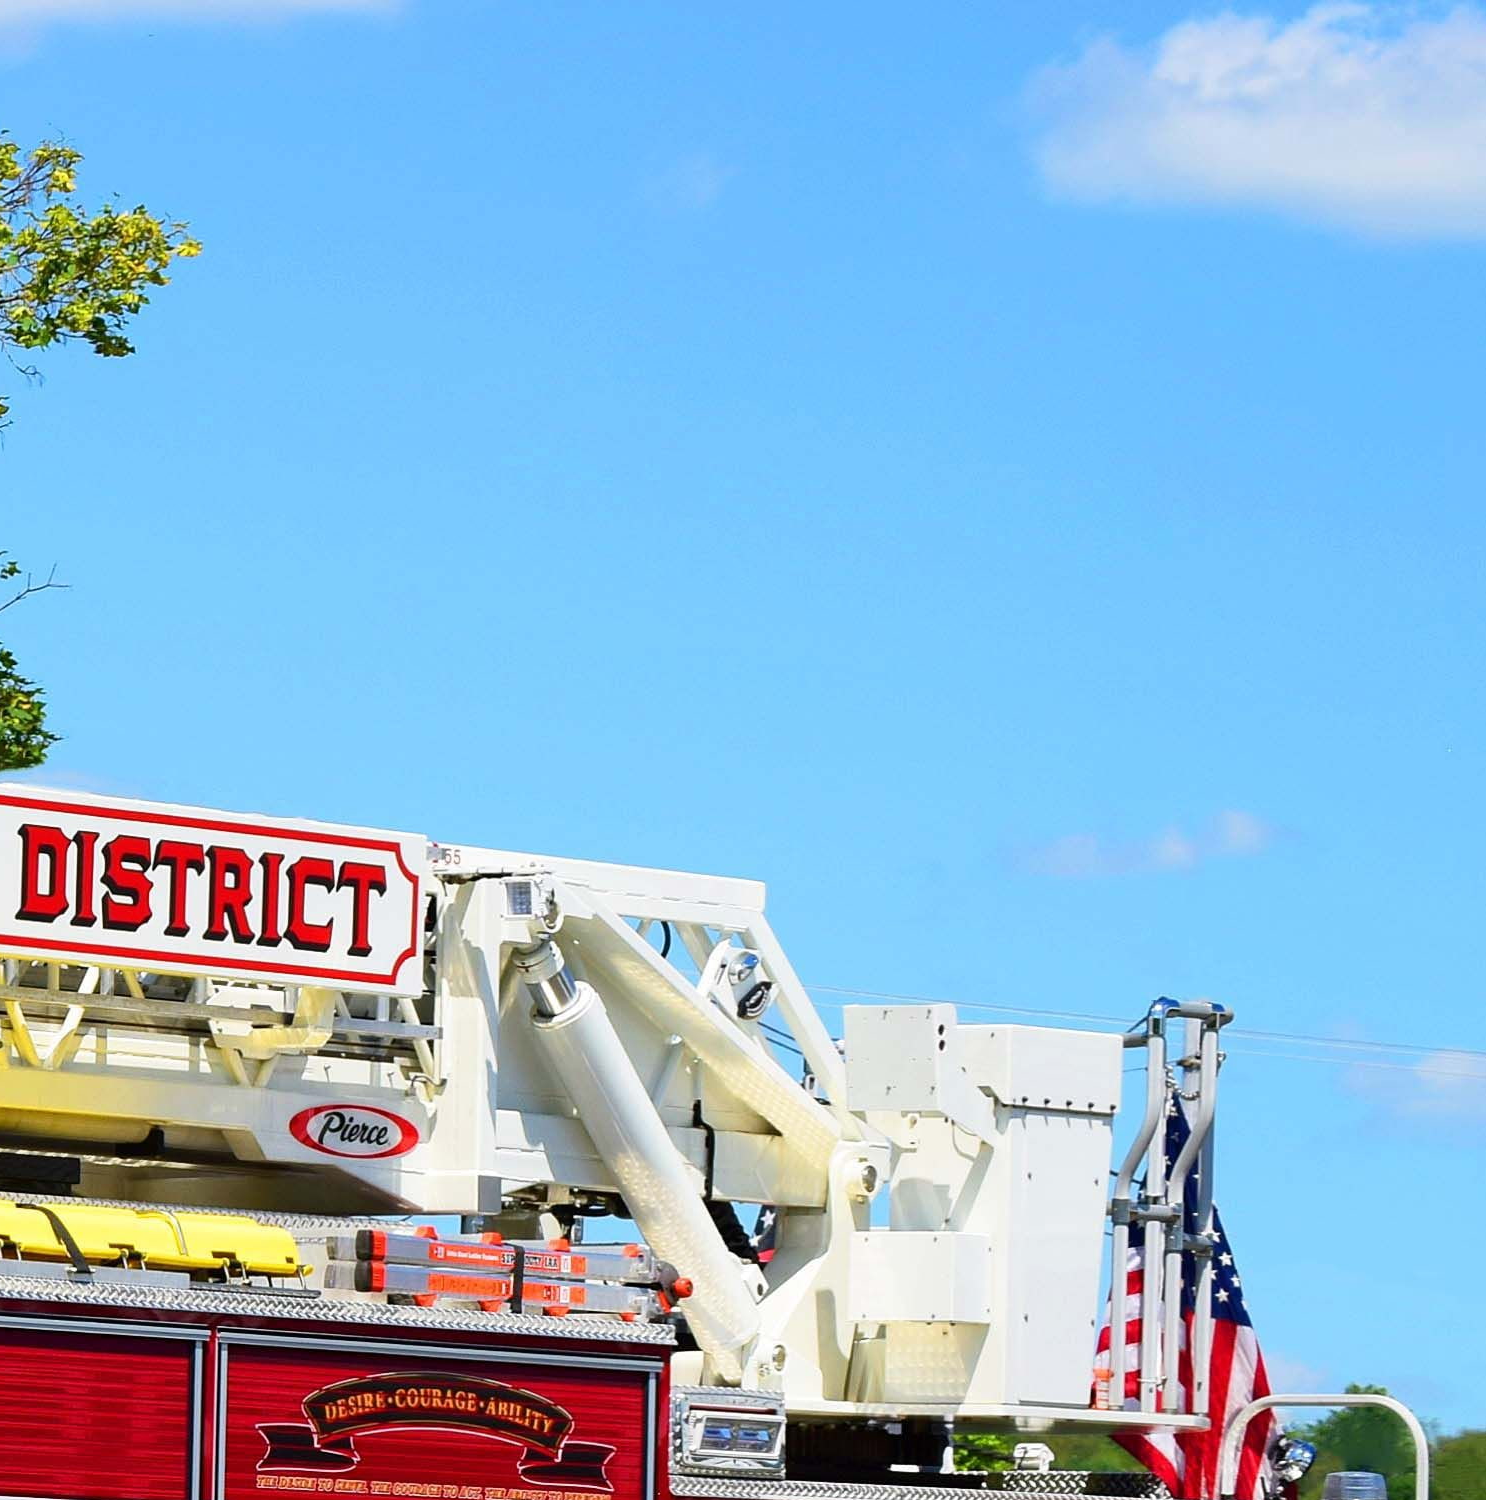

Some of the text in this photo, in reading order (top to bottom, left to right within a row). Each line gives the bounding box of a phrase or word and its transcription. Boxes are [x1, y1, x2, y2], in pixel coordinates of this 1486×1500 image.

[15, 822, 388, 958] DISTRICT
[317, 1111, 389, 1146] Pierce
[325, 1387, 553, 1433] DESIRE COURAGE ABILITY
